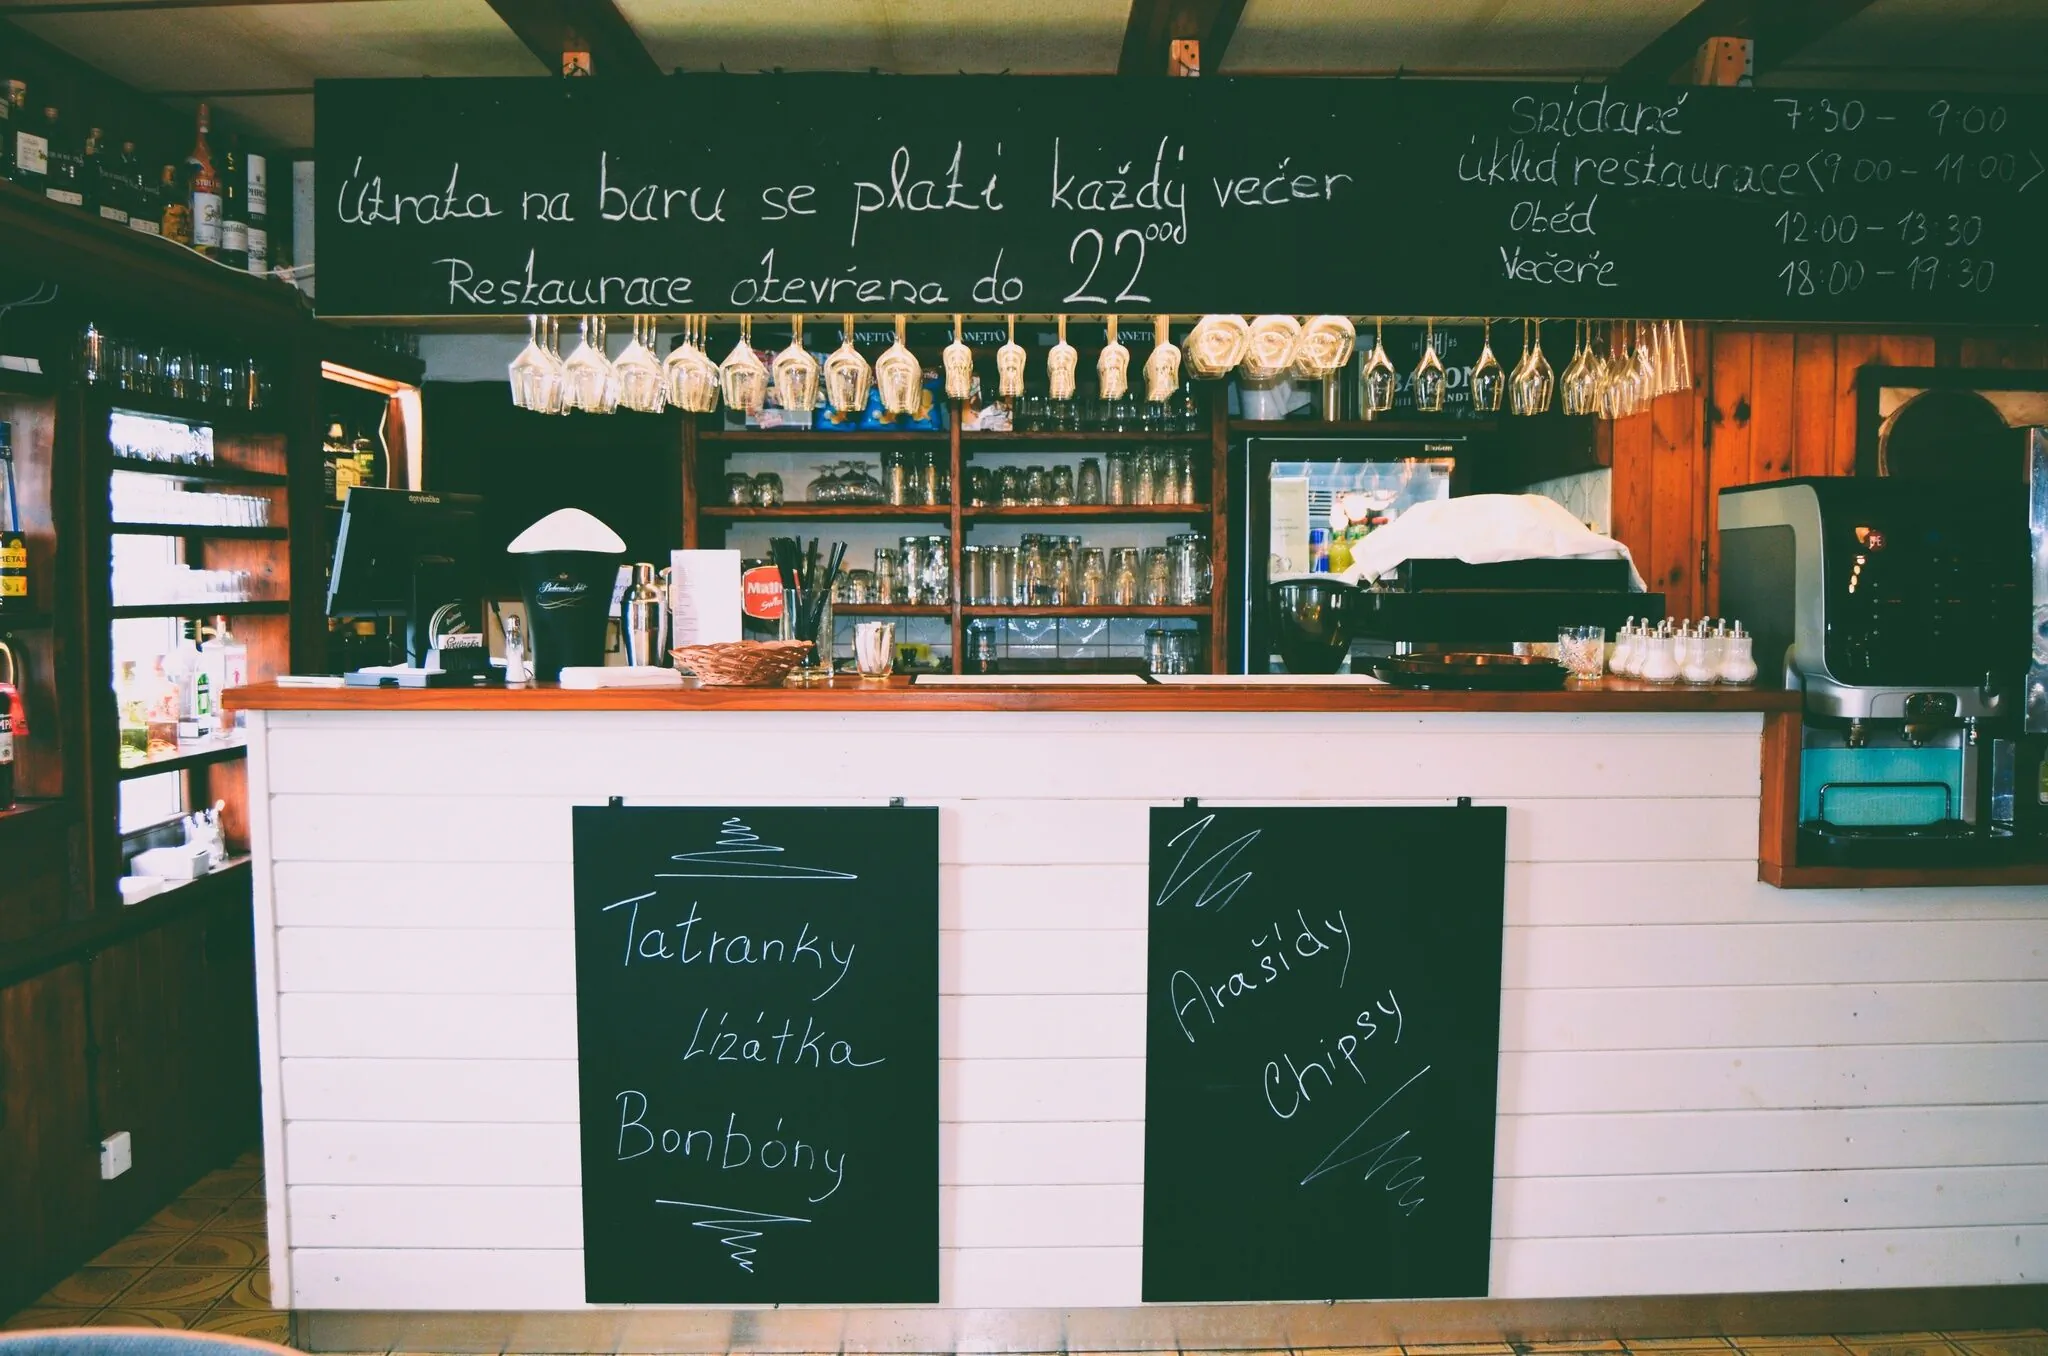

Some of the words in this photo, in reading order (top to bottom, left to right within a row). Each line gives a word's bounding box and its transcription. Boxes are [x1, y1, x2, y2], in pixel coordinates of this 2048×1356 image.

[1773, 98, 1865, 132] 7:30
[521, 191, 576, 223] na
[599, 150, 727, 223] baru
[760, 184, 817, 221] se
[1212, 156, 1354, 208] večer
[1573, 143, 1802, 195] restaurace
[431, 247, 694, 306] Restaurace
[971, 247, 1024, 306] do
[601, 890, 856, 1002] Tatranky
[1170, 908, 1351, 1043] Arašídy
[682, 1007, 886, 1068] Lízátka
[1264, 989, 1403, 1120] Chipsy
[615, 1090, 846, 1203] Bonbóny
